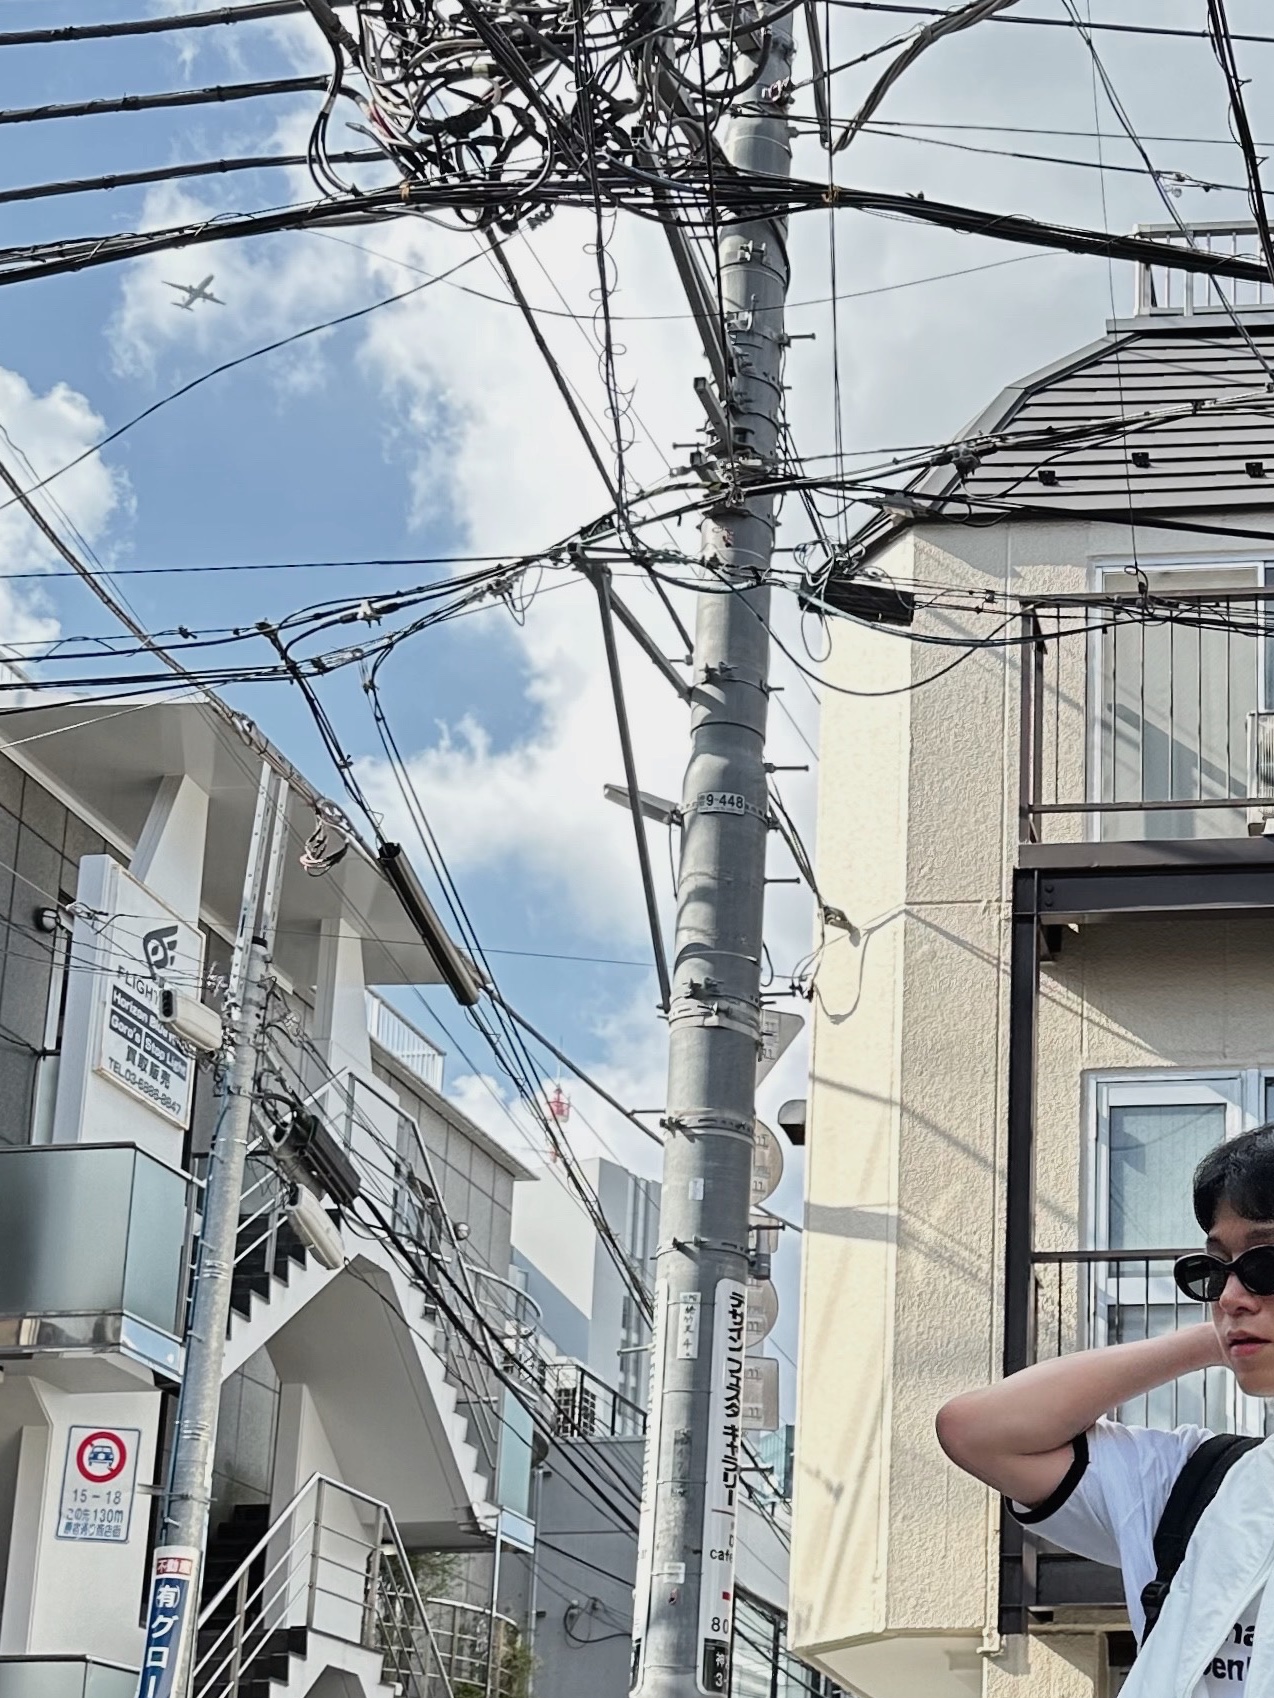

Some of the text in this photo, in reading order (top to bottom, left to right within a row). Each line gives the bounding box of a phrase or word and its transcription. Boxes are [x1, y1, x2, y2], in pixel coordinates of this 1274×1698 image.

[113, 989, 148, 1023] Horizon
[73, 1489, 88, 1503] 15
[106, 1490, 122, 1505] 18
